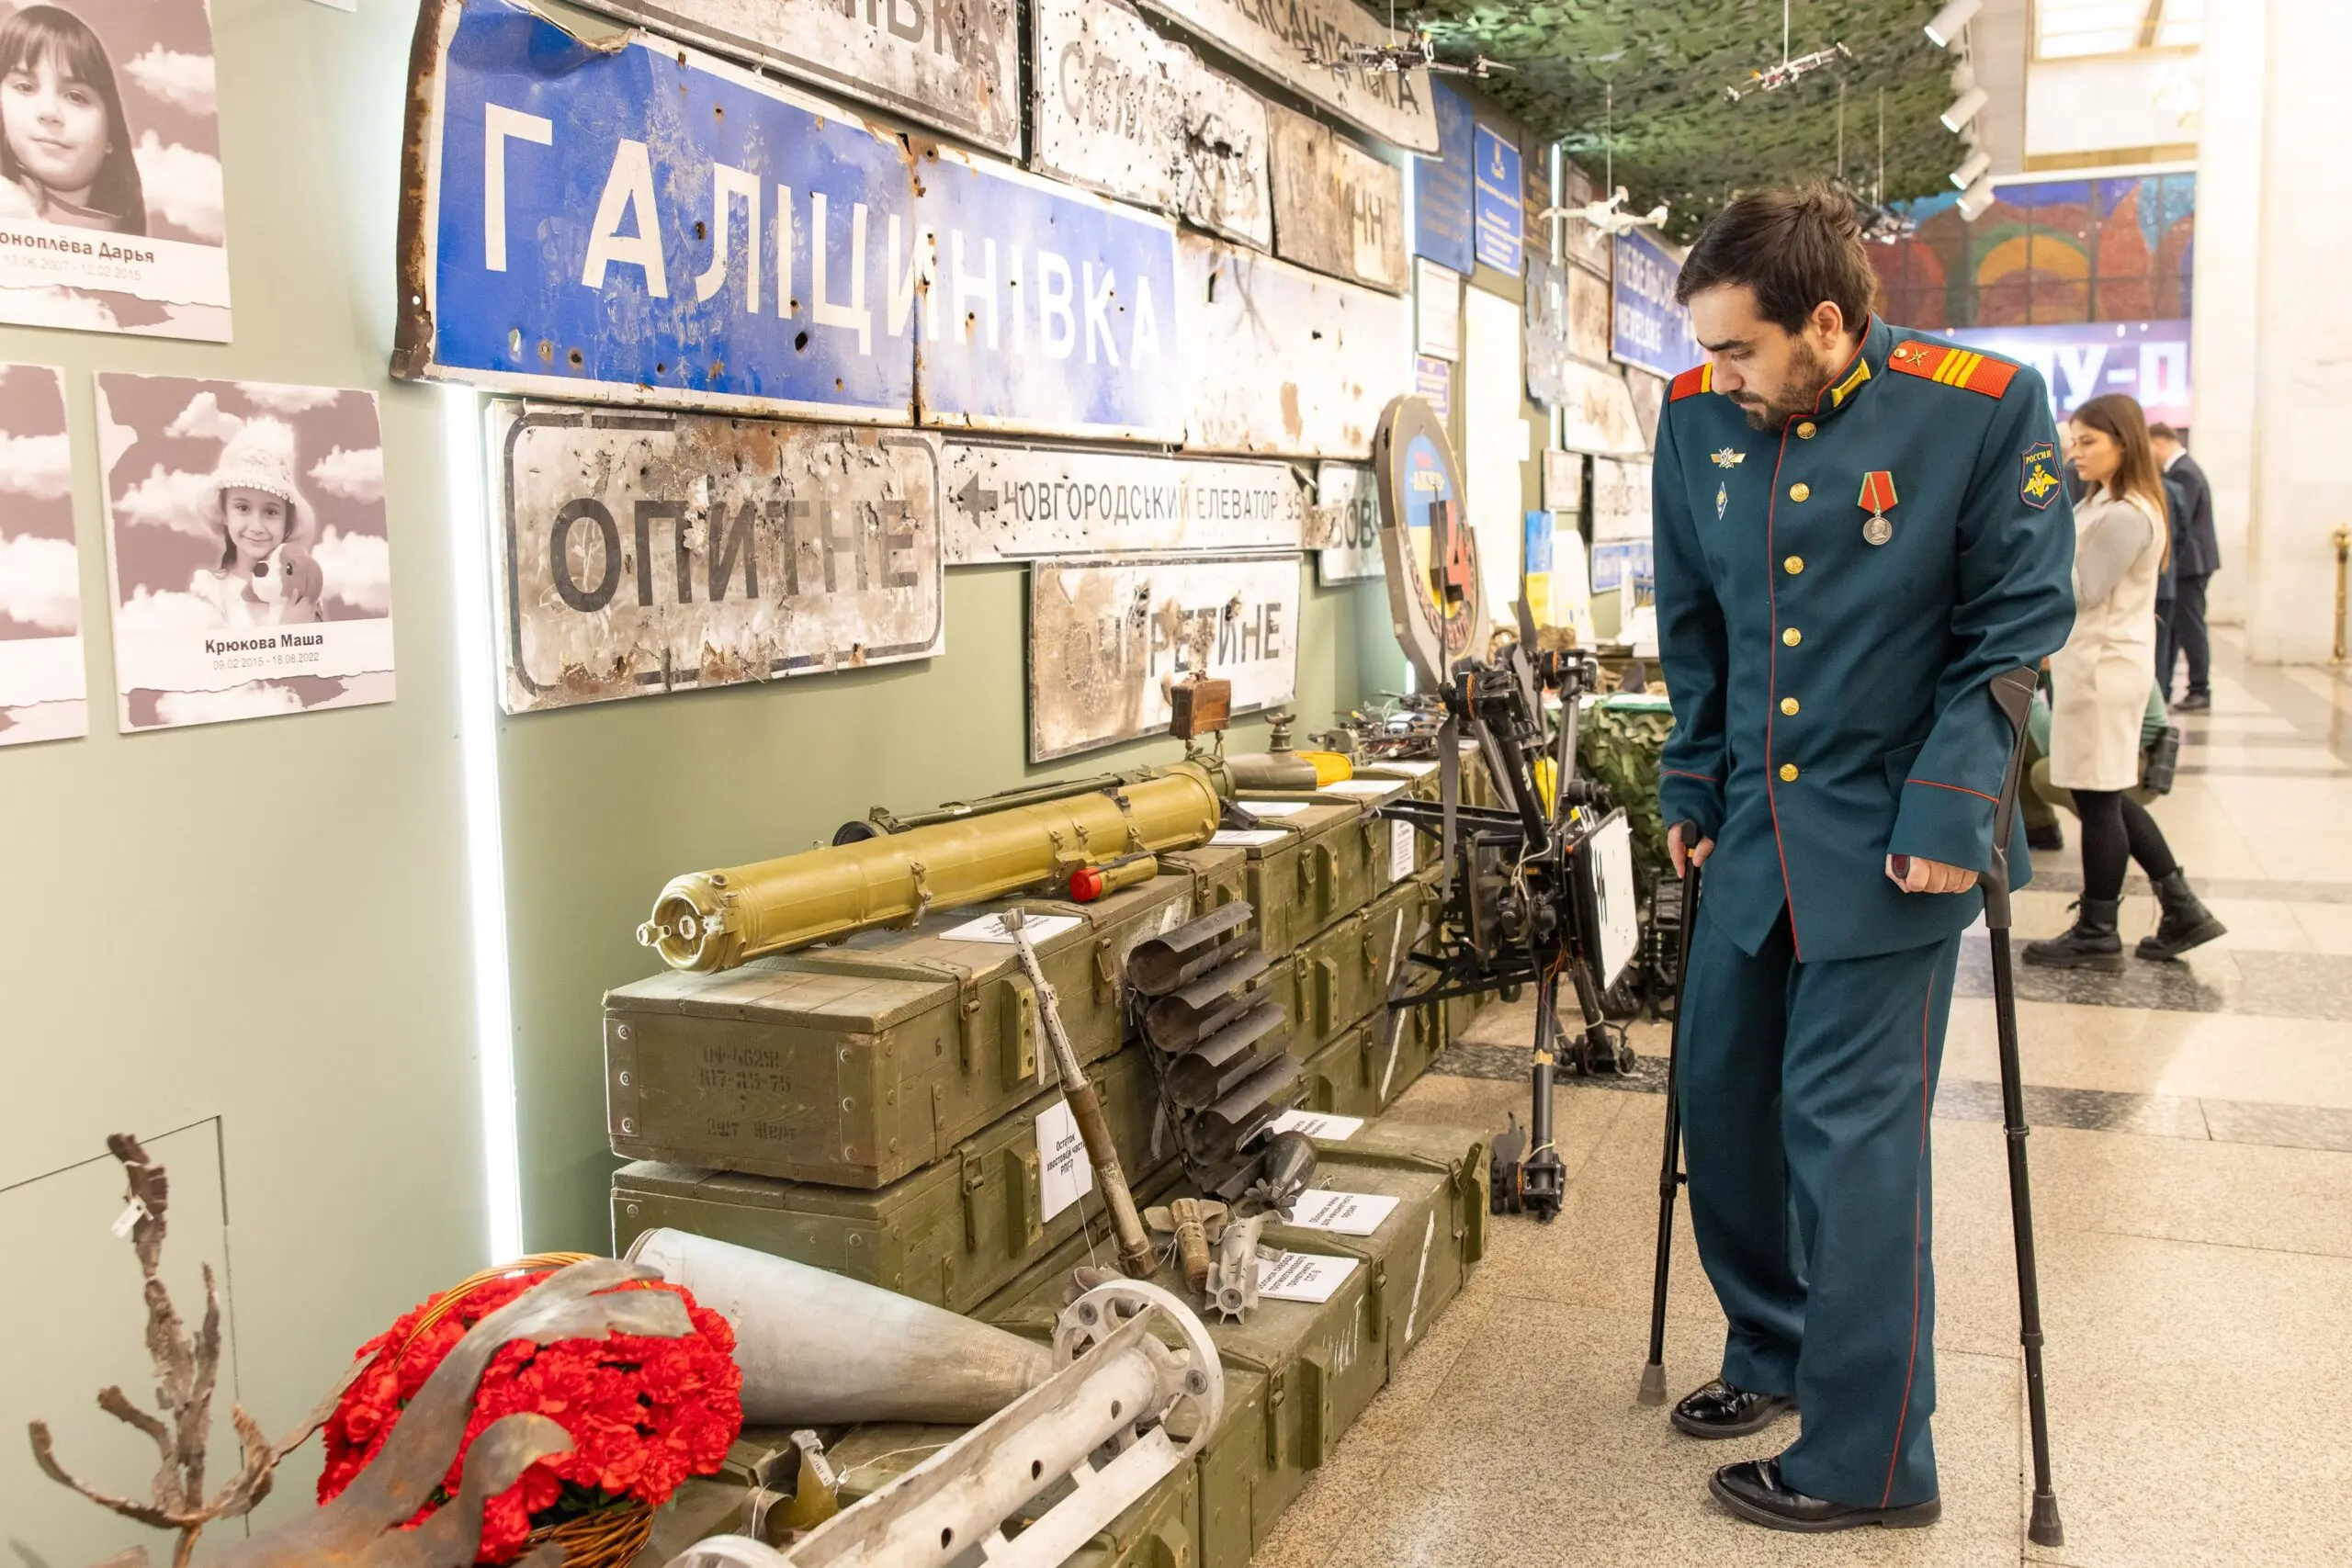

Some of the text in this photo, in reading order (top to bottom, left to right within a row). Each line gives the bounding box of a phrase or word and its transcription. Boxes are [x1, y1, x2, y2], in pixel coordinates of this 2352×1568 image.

[485, 102, 1161, 370] ГАЛІЦИНІВКА
[98, 242, 155, 264] Дарья
[2026, 449, 2052, 465] РОССИЯ
[1197, 488, 1278, 521] ЕЛЕВАТОР
[550, 498, 919, 613] ОПИТНЕ
[205, 633, 323, 656] Крюкова Маша
[1046, 1146, 1072, 1172] хвостовой
